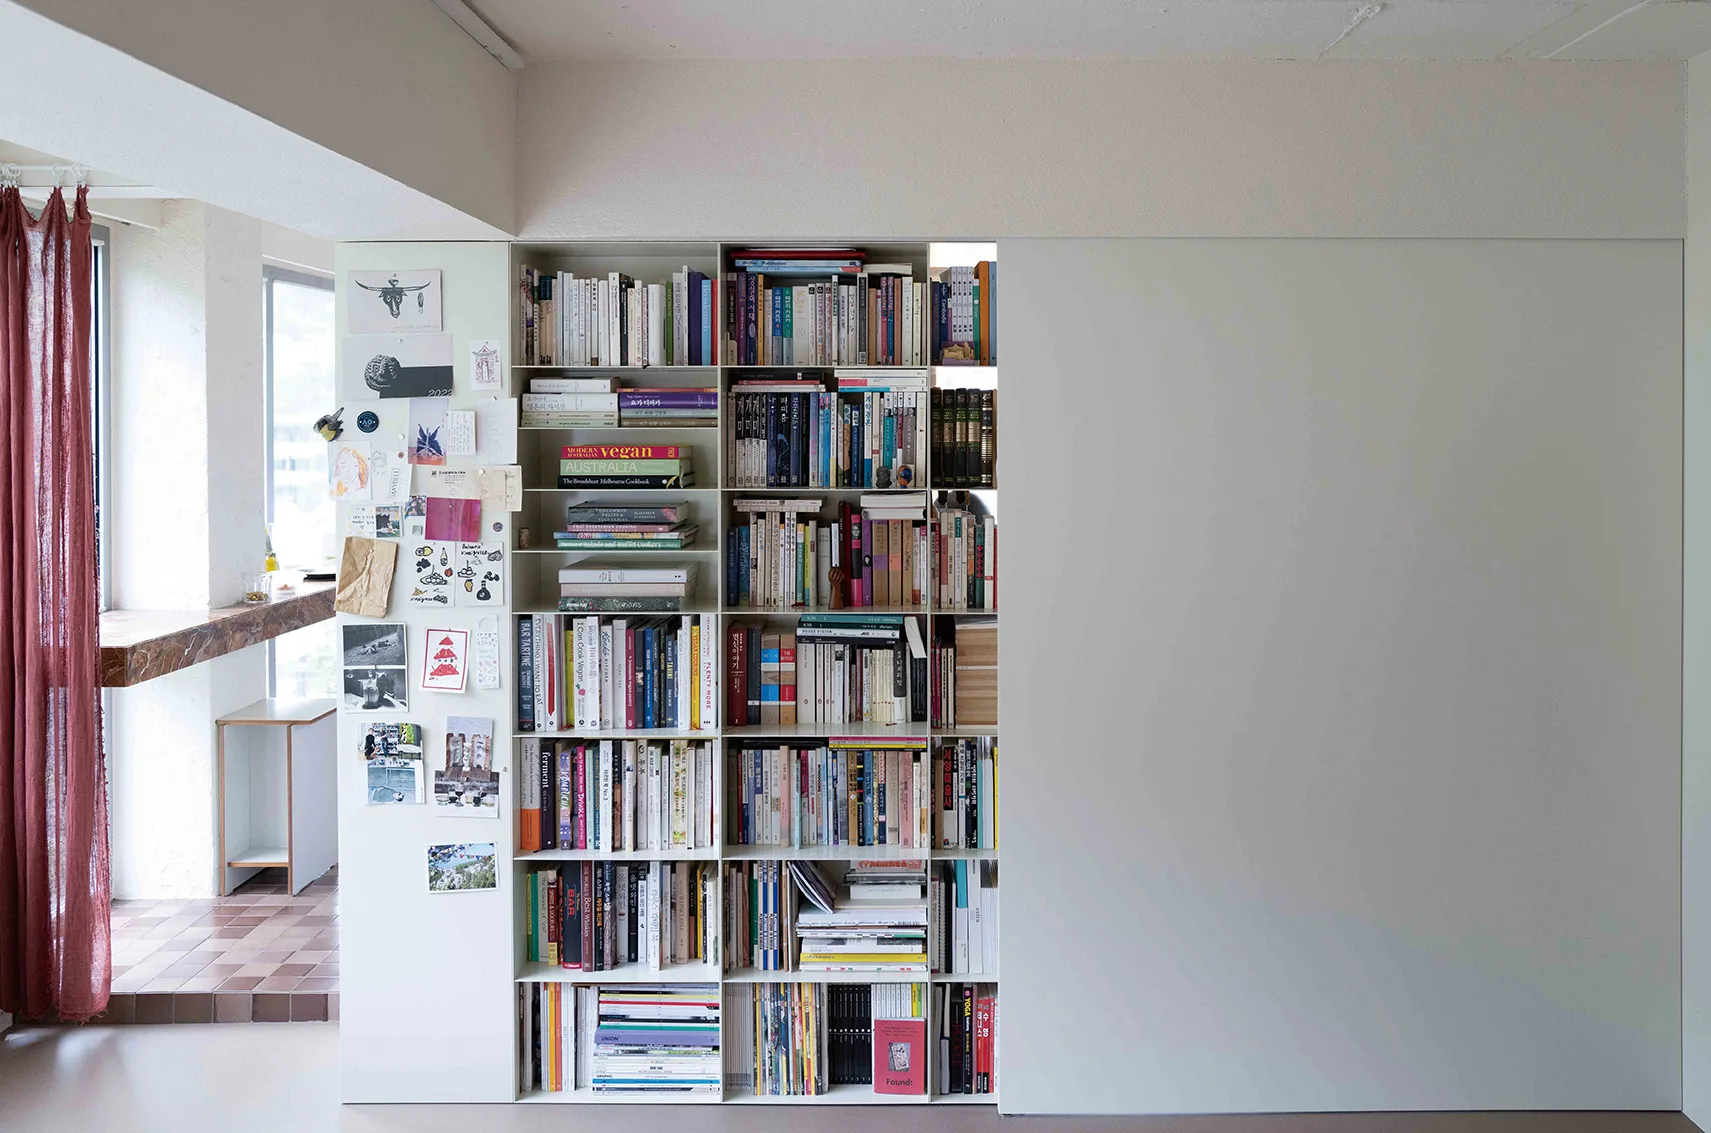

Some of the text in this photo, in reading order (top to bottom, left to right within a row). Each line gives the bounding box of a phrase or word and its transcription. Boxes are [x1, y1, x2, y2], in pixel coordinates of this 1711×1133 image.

[566, 462, 637, 472] AUSTRALIA
[600, 447, 652, 458] vegan
[521, 623, 530, 666] BAR TARTINE
[575, 661, 584, 682] Vegan
[542, 752, 550, 789] ferment
[560, 771, 569, 809] KOMBUCHA
